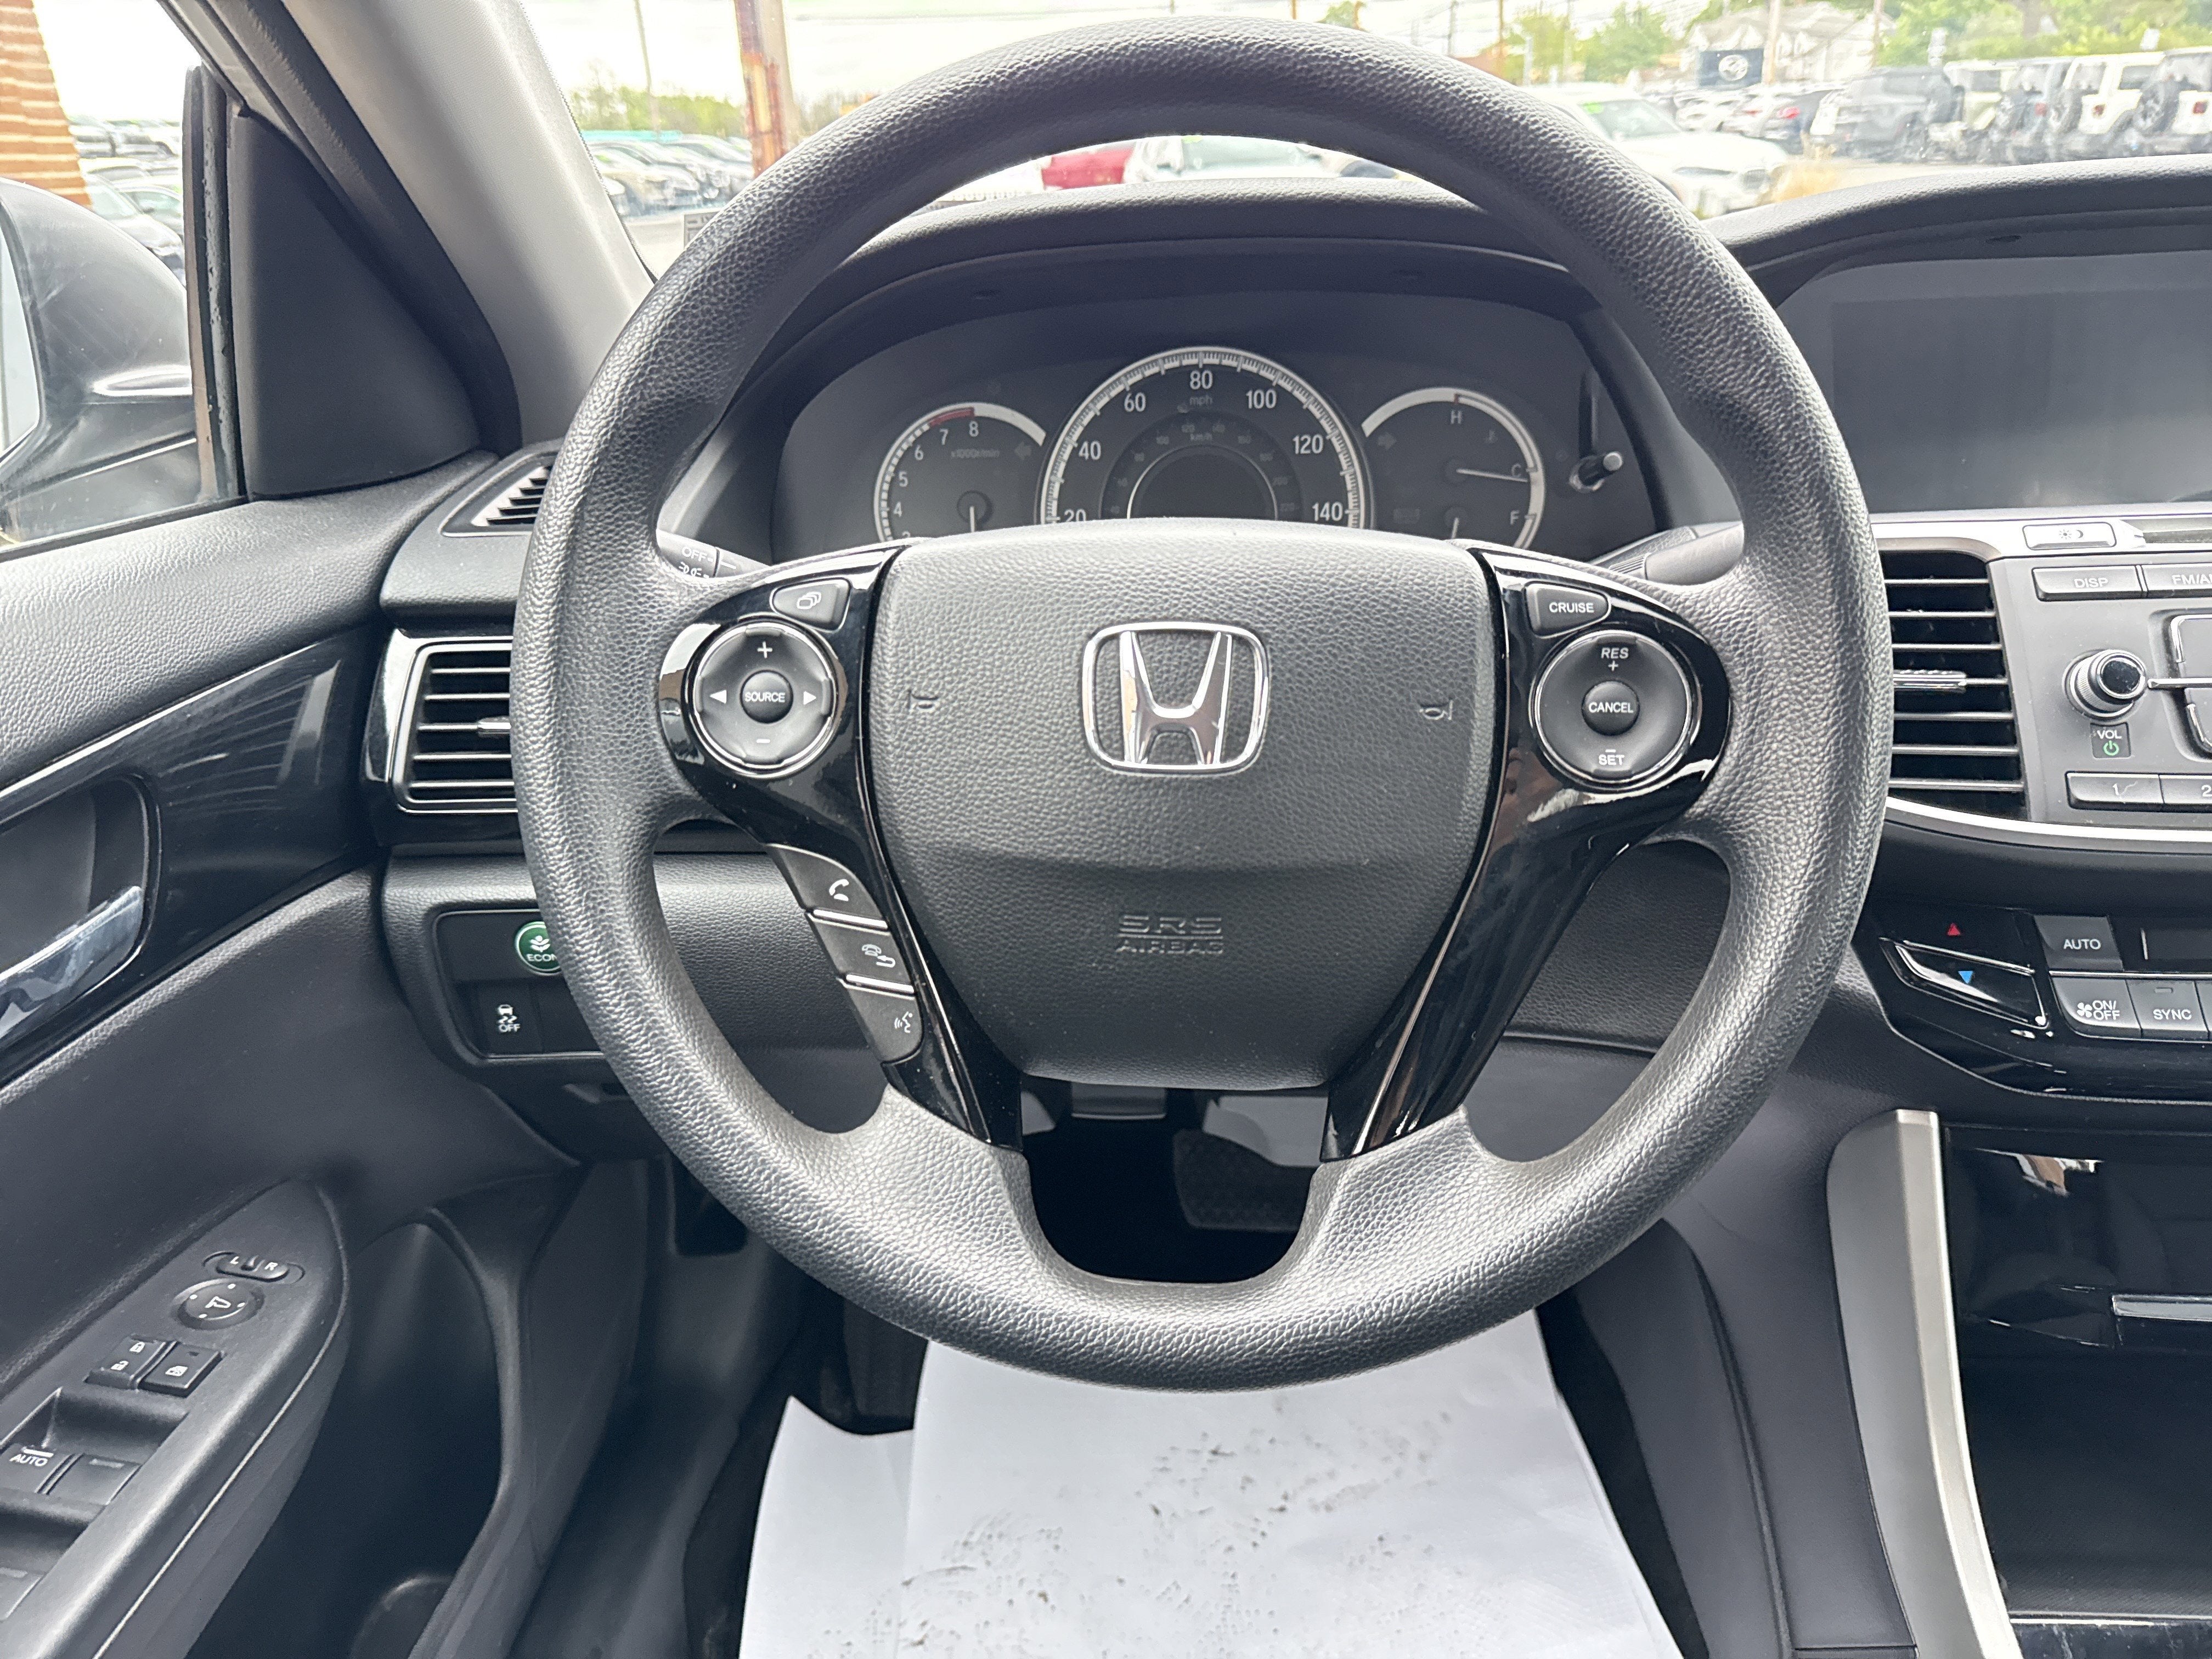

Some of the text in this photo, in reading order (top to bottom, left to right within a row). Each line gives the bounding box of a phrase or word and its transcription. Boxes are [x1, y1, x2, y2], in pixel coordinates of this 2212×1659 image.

[1189, 370, 1213, 390] 80
[1124, 393, 1146, 412] 60
[1246, 390, 1277, 410] 100
[1450, 410, 1463, 425] H
[969, 422, 979, 437] 8
[940, 430, 949, 445] 7
[1079, 441, 1101, 460] 40
[1293, 435, 1324, 455] 120
[915, 445, 924, 461] 6
[1511, 464, 1521, 477] C
[899, 472, 908, 487] 5
[893, 502, 902, 516] 4
[1312, 502, 1343, 521] 140
[1064, 509, 1087, 522] 20
[1510, 510, 1520, 525] F
[681, 547, 707, 561] OFF
[2074, 578, 2109, 589] DISP
[2172, 574, 2212, 585] FM/A
[1549, 603, 1594, 613] CRUISE
[1601, 647, 1629, 659] RES
[744, 692, 785, 703] SOURCE
[1588, 702, 1634, 713] CANCEL
[2097, 730, 2122, 740] VOL
[1598, 754, 1625, 765] SET
[2112, 783, 2119, 795] 1
[2201, 785, 2212, 797] 2
[1119, 915, 1222, 934] SRS
[2063, 939, 2101, 950] AUTO
[2093, 1000, 2117, 1011] ON/
[2093, 1010, 2120, 1020] OFF
[2153, 1009, 2192, 1020] SYNC
[498, 1024, 521, 1032] OFF
[230, 1256, 239, 1265] L
[264, 1262, 278, 1271] R
[10, 1454, 49, 1466] AUTO
